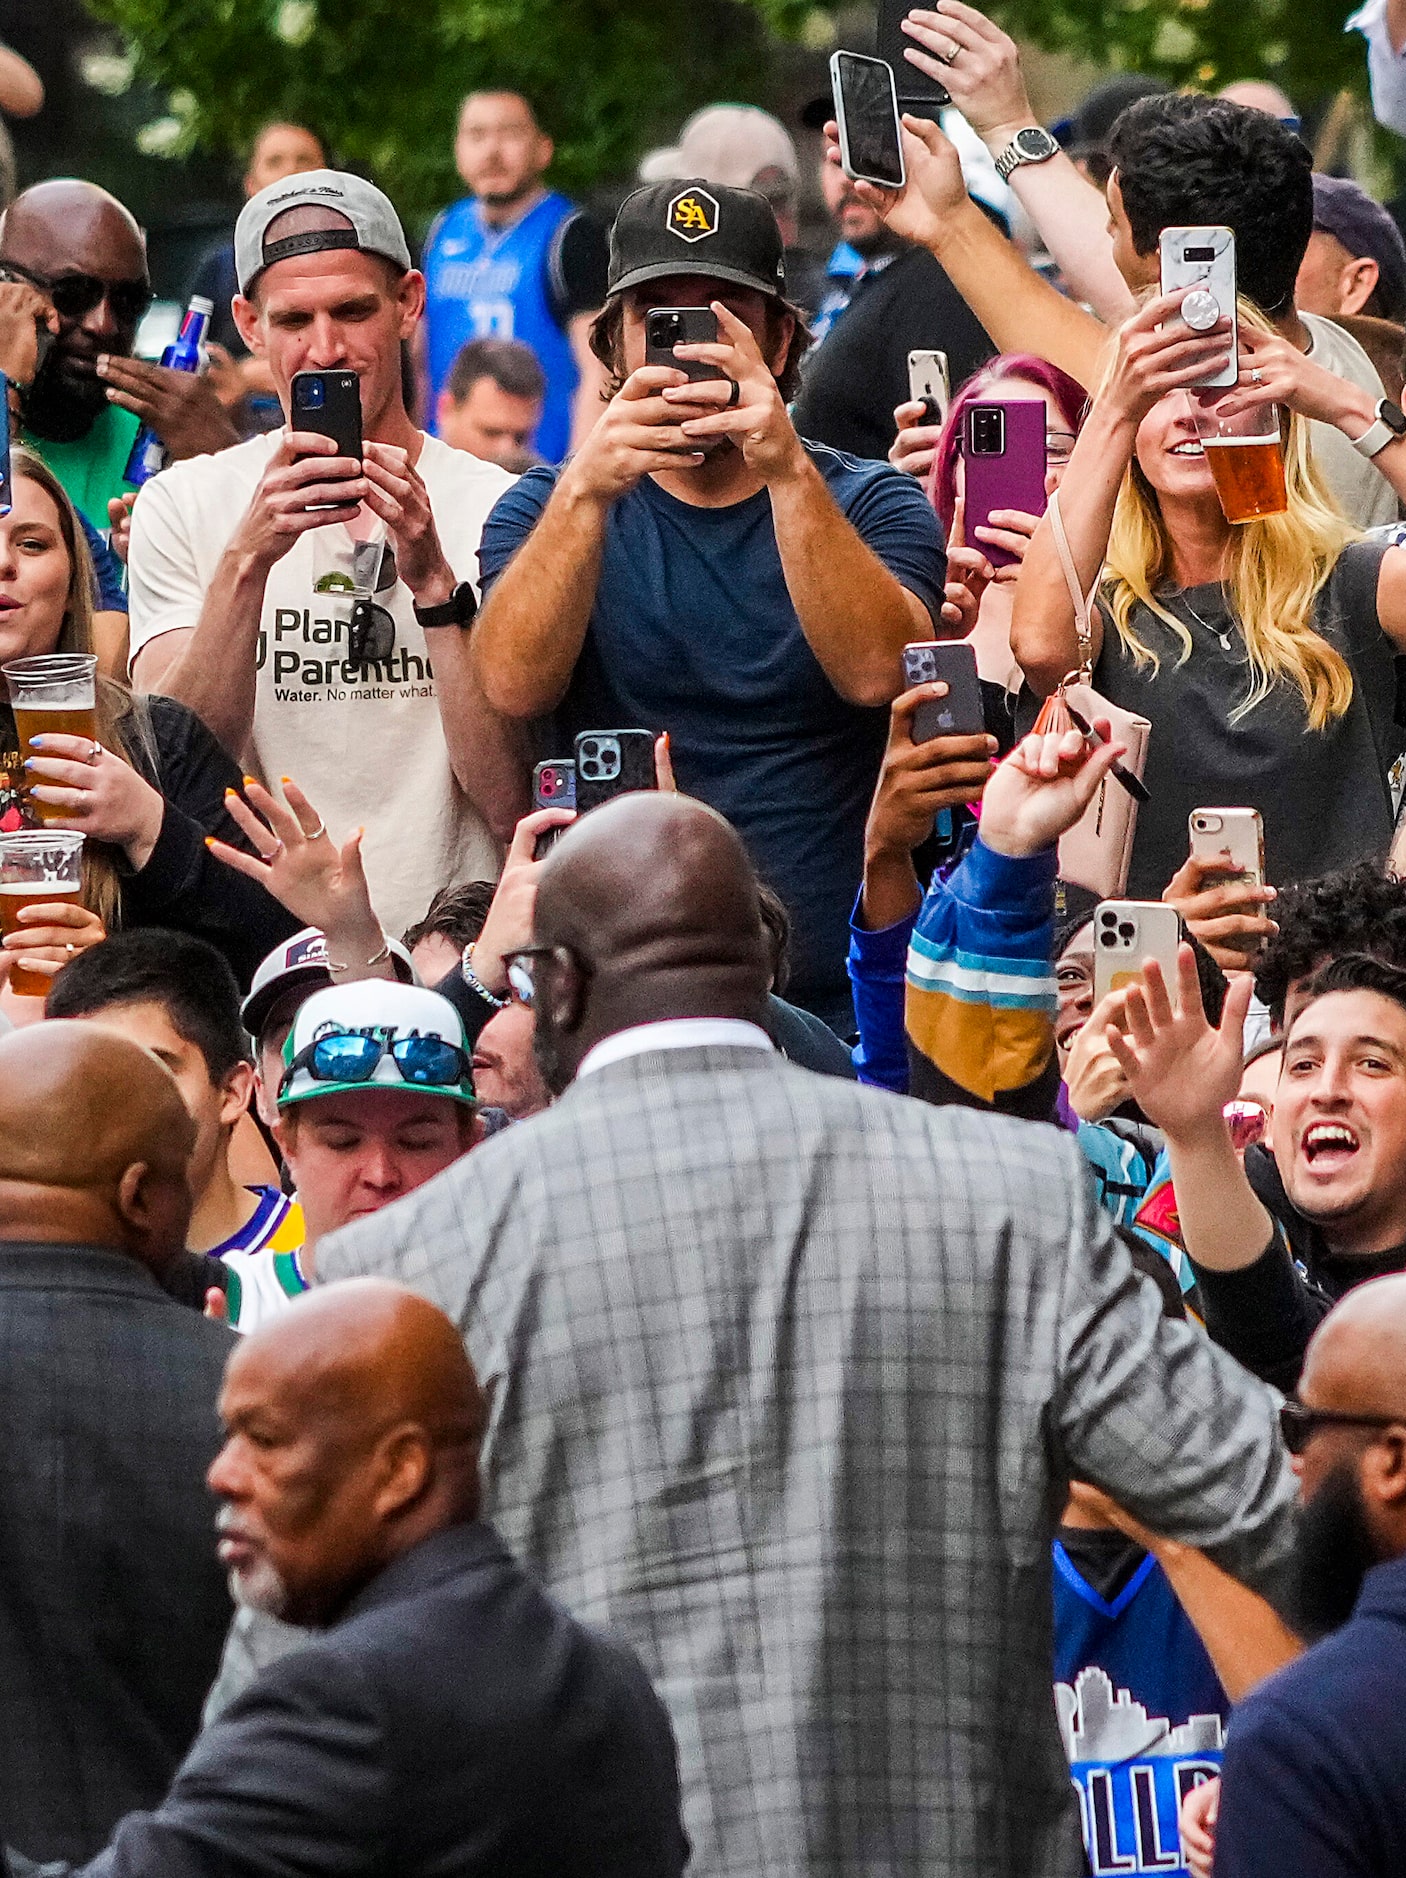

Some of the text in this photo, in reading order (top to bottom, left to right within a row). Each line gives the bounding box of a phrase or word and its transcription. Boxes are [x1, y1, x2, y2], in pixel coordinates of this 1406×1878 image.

[675, 198, 711, 230] SA
[275, 684, 438, 702] Water. No matter what.
